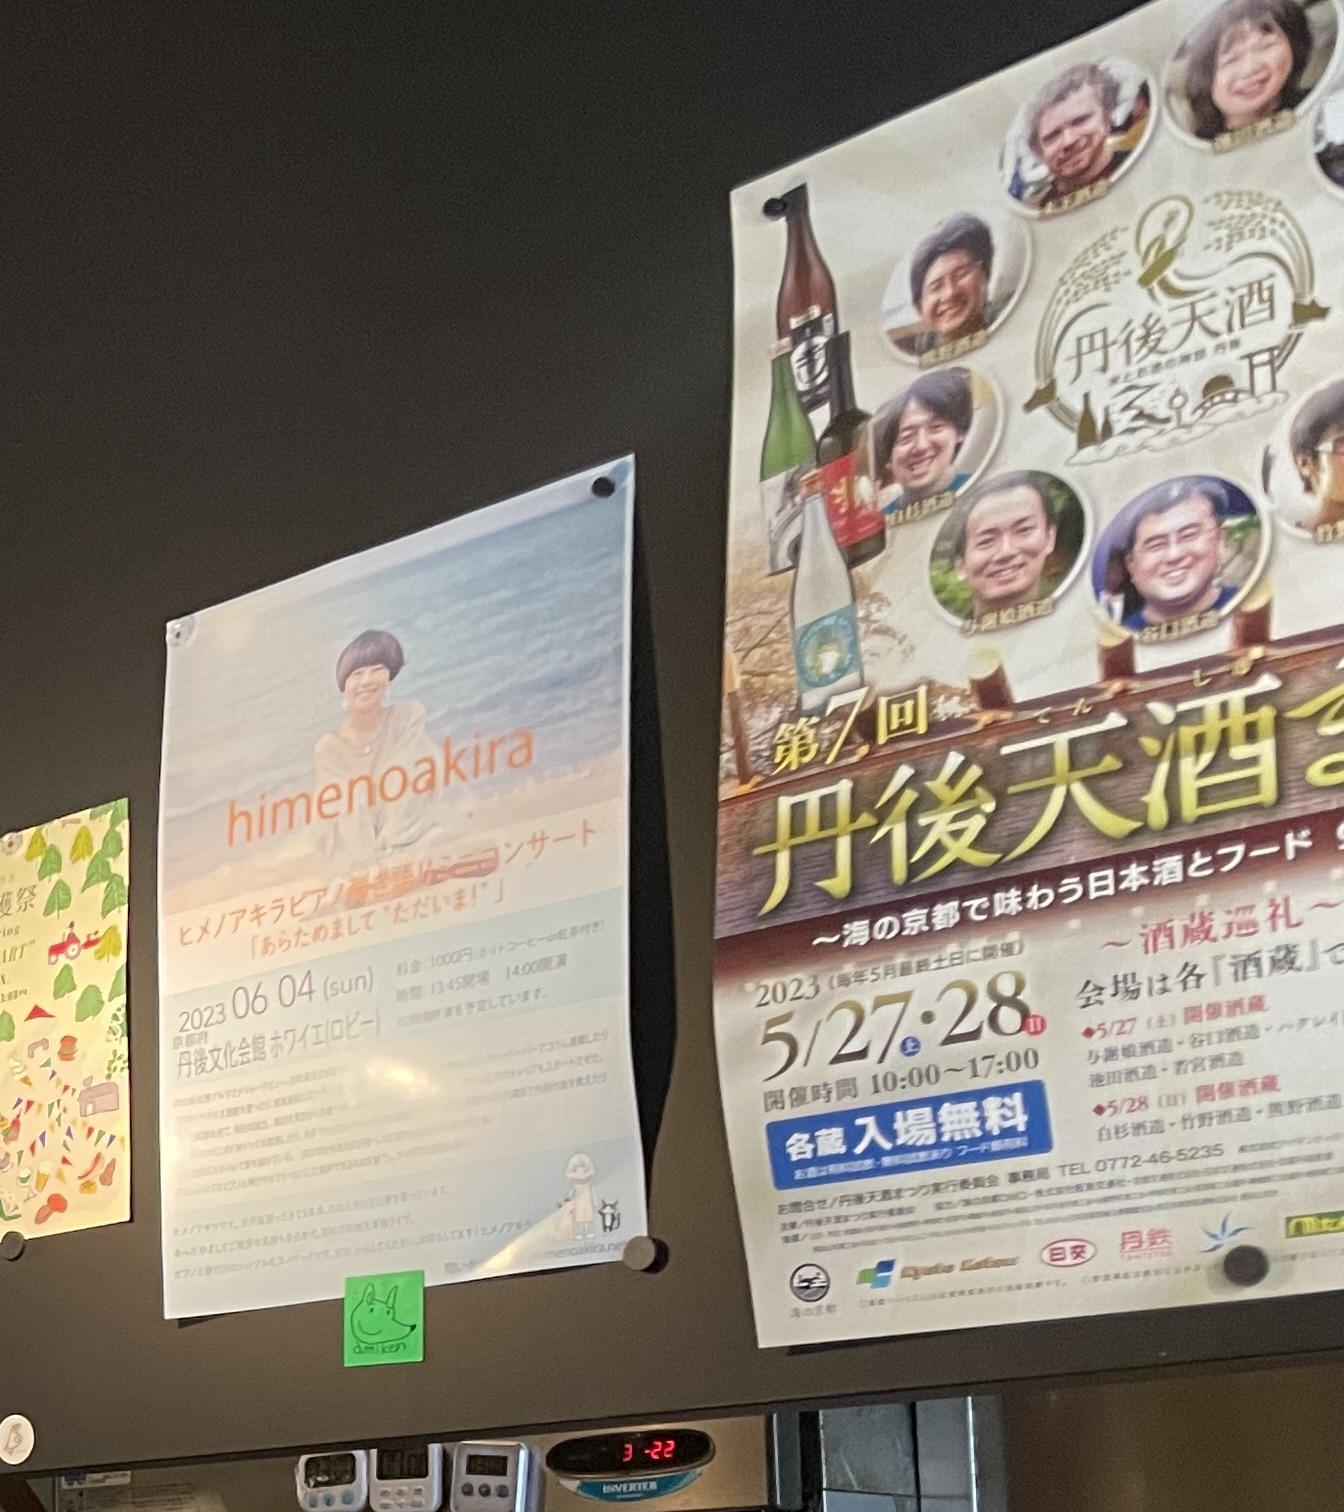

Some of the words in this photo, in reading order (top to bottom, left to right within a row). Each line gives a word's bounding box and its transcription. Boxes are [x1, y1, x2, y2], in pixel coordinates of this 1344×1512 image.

[1067, 274, 1276, 384] 丹後天酒
[227, 726, 534, 848] himenoakira
[756, 974, 820, 1008] 2023
[179, 1002, 226, 1033] 2023
[762, 1077, 858, 1112] 開催時間
[1058, 1162, 1091, 1178] TEL
[1095, 1143, 1224, 1173] 0772-46-5235
[602, 1480, 658, 1494] INVERTER
